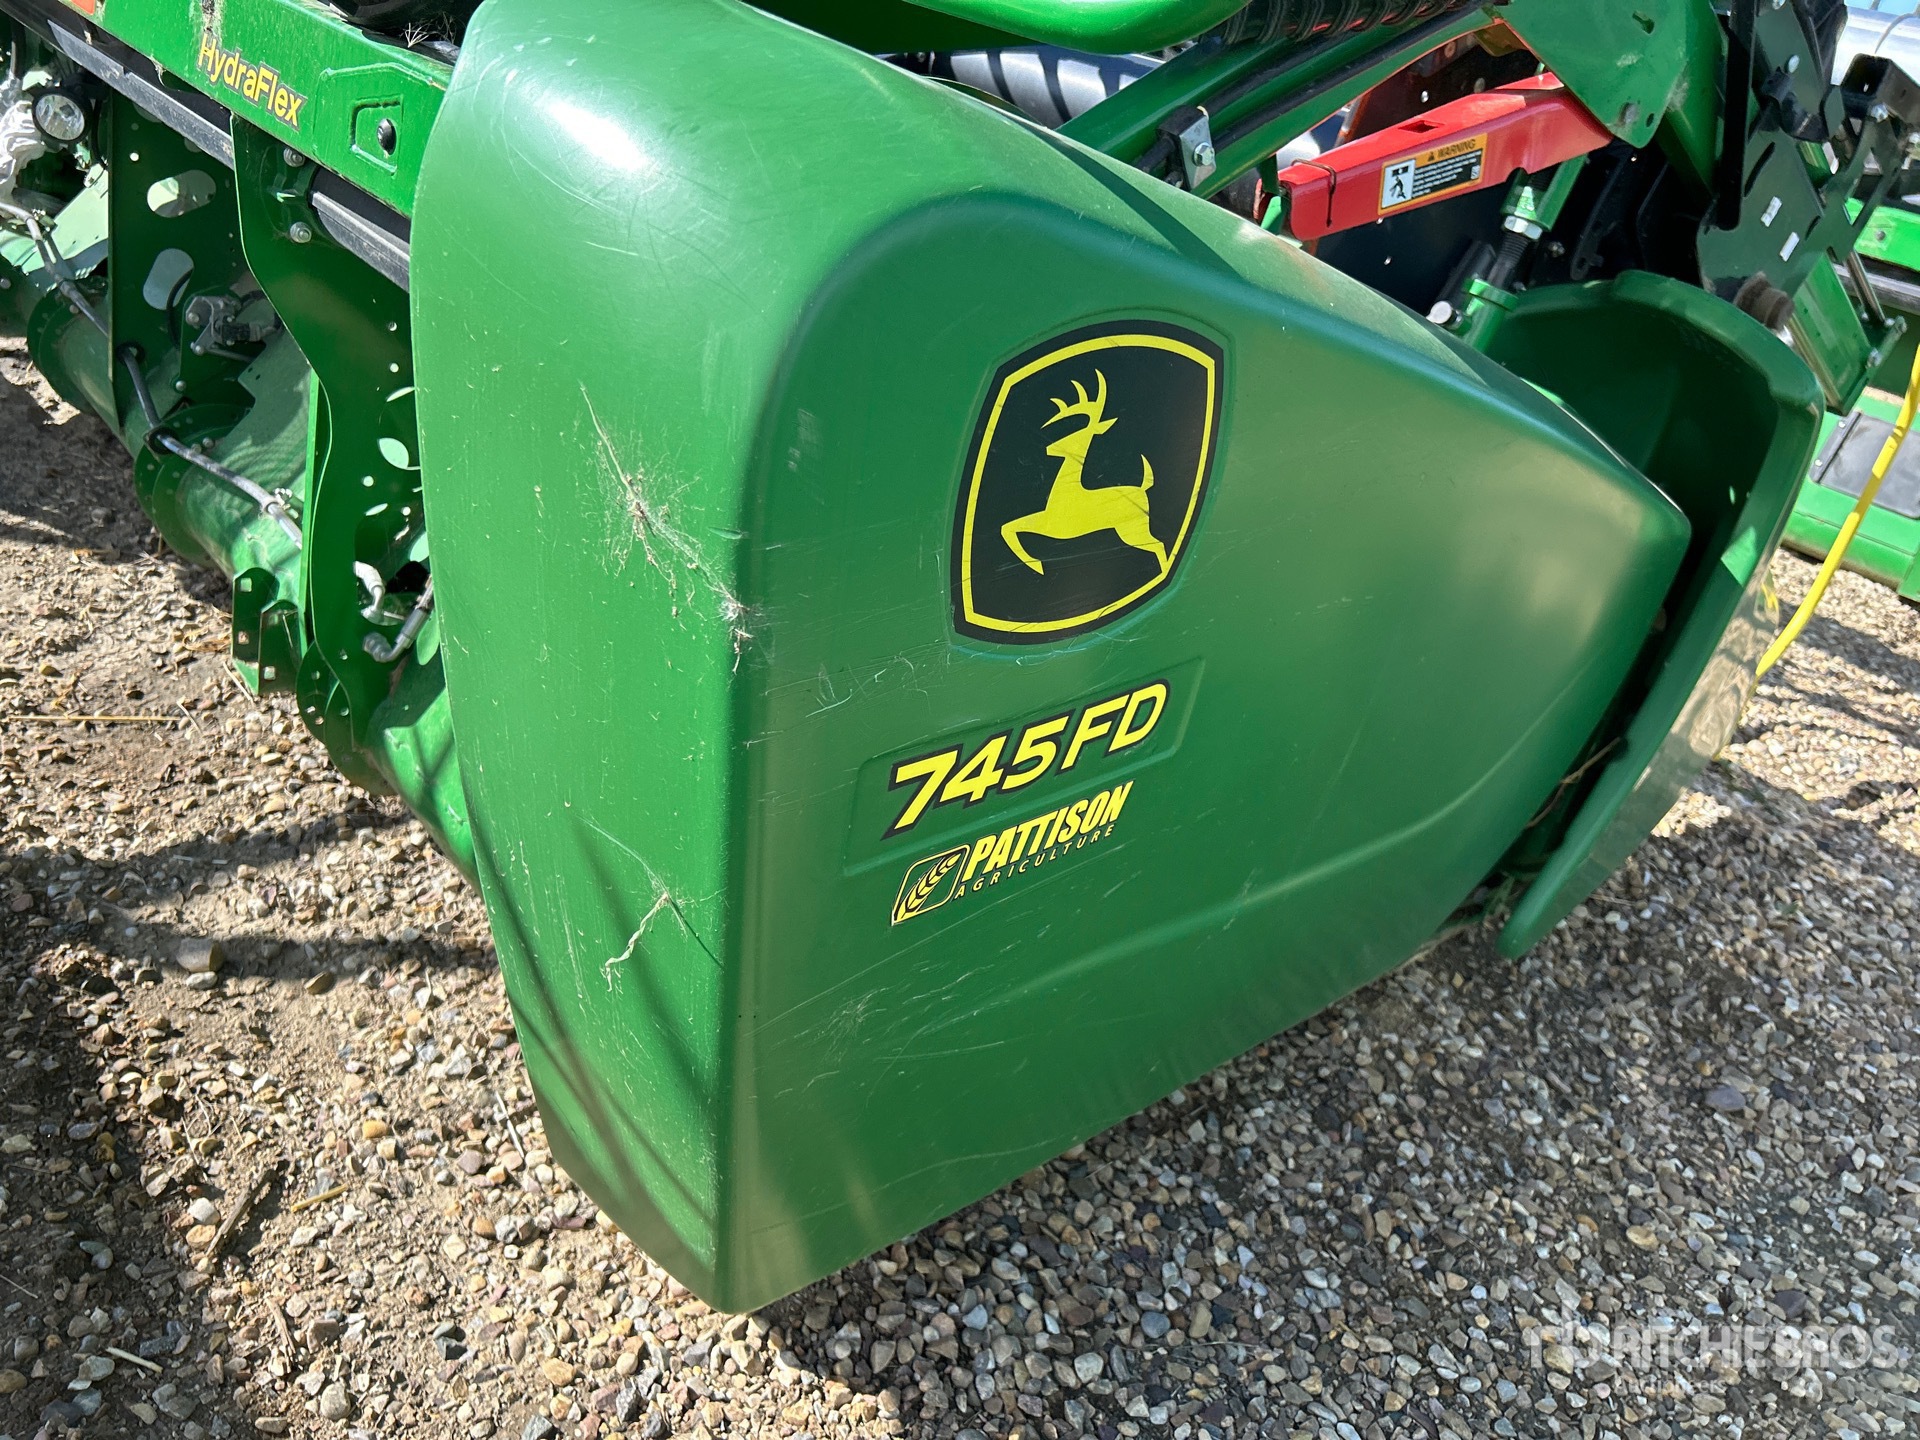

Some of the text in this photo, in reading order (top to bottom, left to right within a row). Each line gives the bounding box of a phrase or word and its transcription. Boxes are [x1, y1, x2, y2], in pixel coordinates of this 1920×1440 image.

[197, 32, 303, 127] HydraFlex
[1437, 138, 1476, 158] WARNING
[889, 681, 1168, 834] 745FD
[955, 823, 1115, 899] AGRICULTURE
[961, 779, 1135, 882] PATTISON
